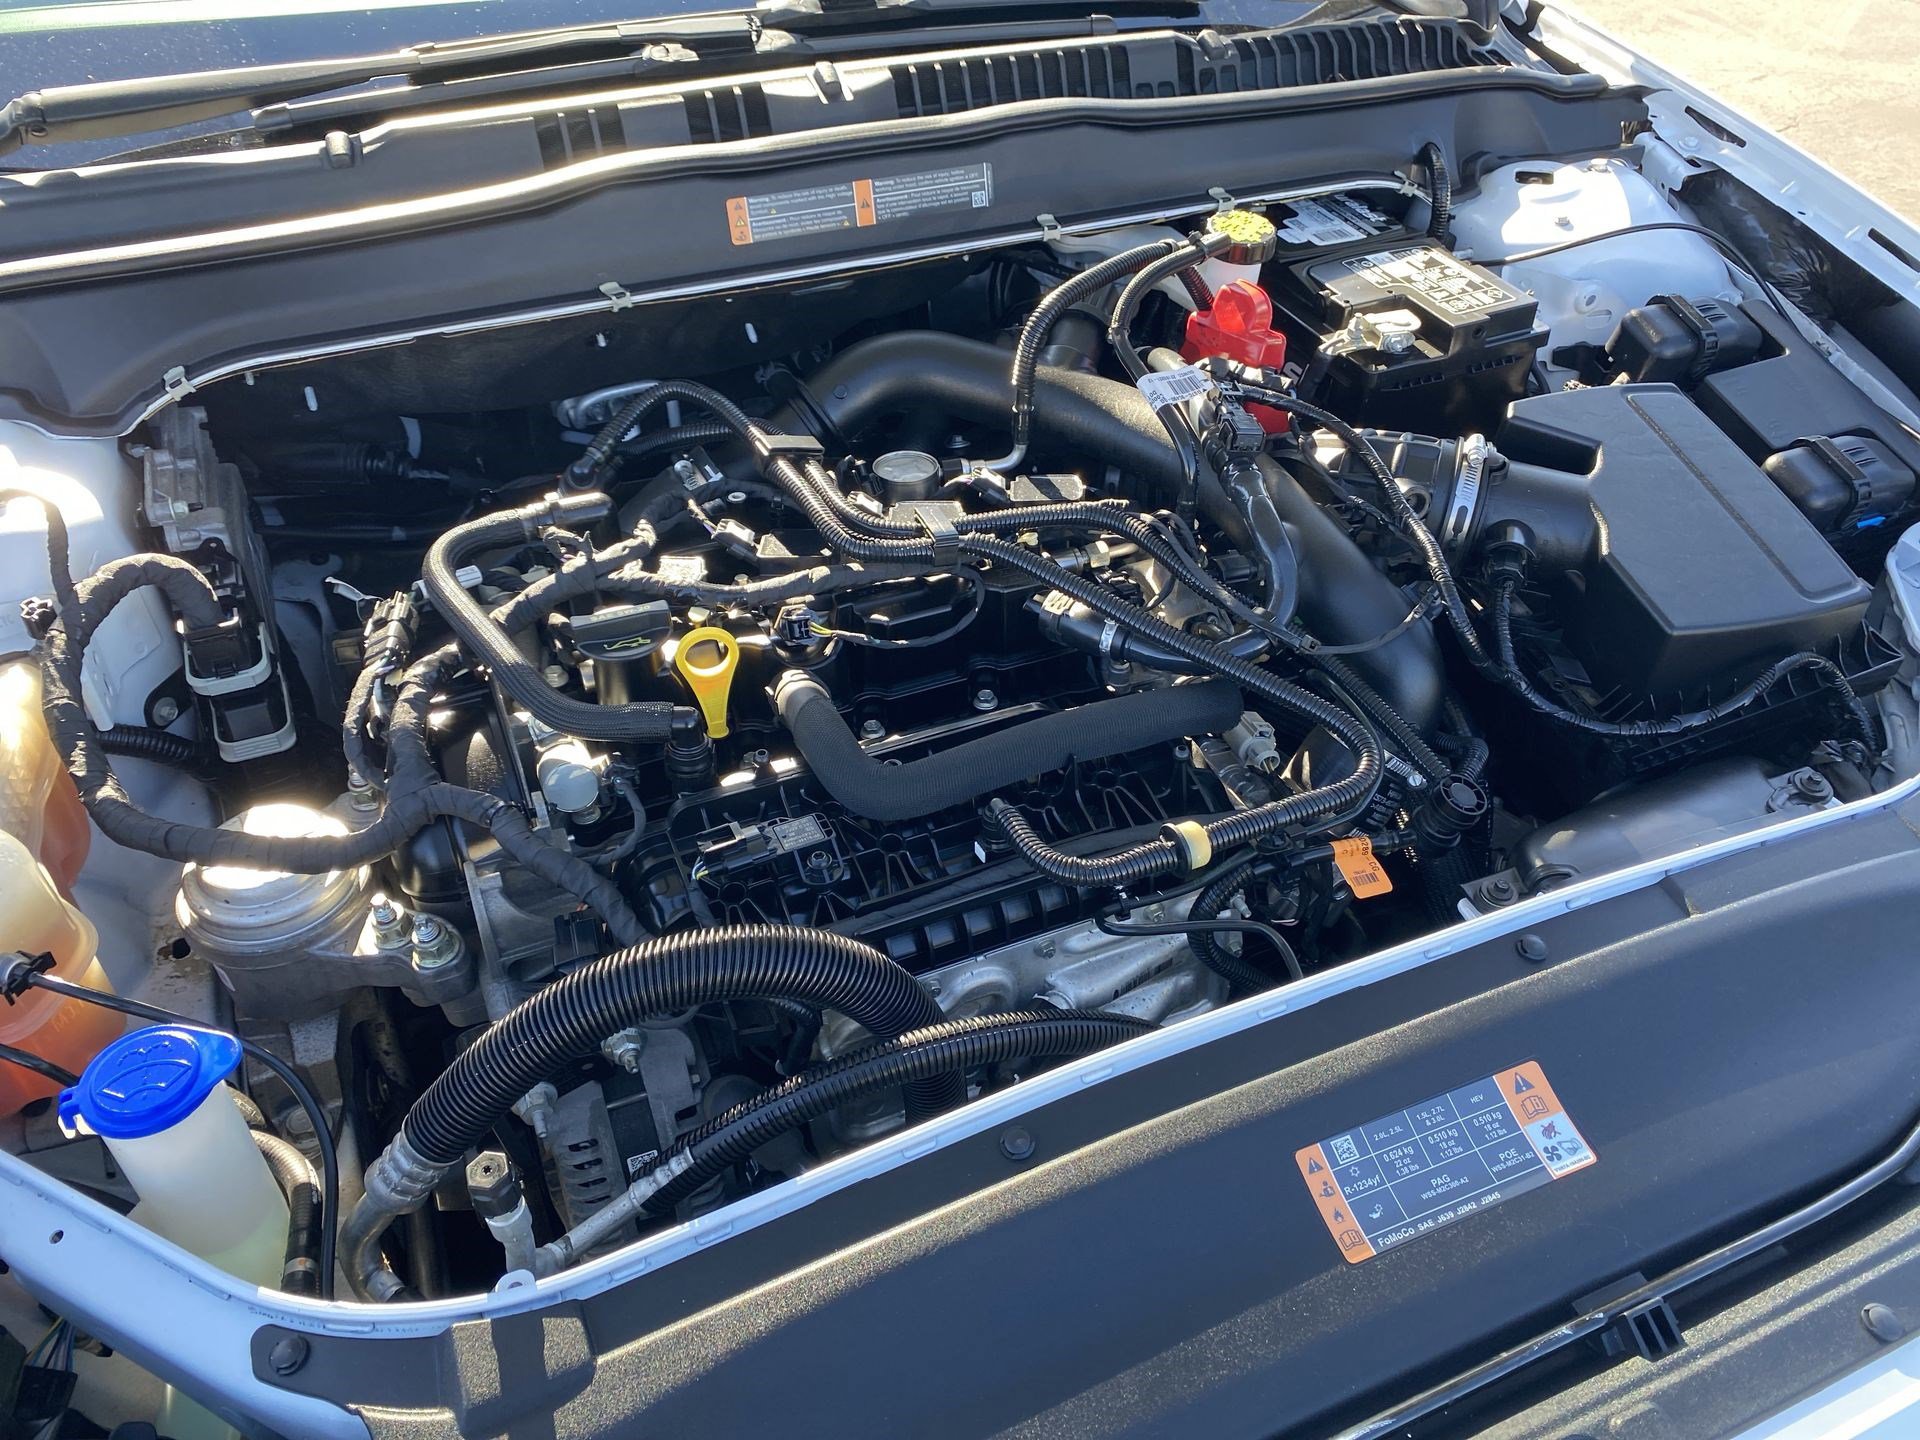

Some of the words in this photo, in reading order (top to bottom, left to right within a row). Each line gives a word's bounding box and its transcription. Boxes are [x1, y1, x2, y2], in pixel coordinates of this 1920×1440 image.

[1470, 1094, 1484, 1104] HEV
[1473, 1114, 1492, 1126] 0.510
[1491, 1111, 1502, 1120] kg
[1428, 1130, 1448, 1144] 0.510
[1446, 1128, 1458, 1138] kg
[1383, 1148, 1403, 1162] 0.624
[1403, 1146, 1414, 1155] kg
[1498, 1148, 1518, 1162] POE
[1344, 1174, 1380, 1195] R-1234yf
[1430, 1174, 1451, 1188] PAG
[1378, 1226, 1415, 1247] FoMoCo
[1418, 1219, 1435, 1231] SAE
[1437, 1210, 1454, 1223] J639
[1456, 1202, 1477, 1215] J2842
[1480, 1191, 1501, 1205] J2845
